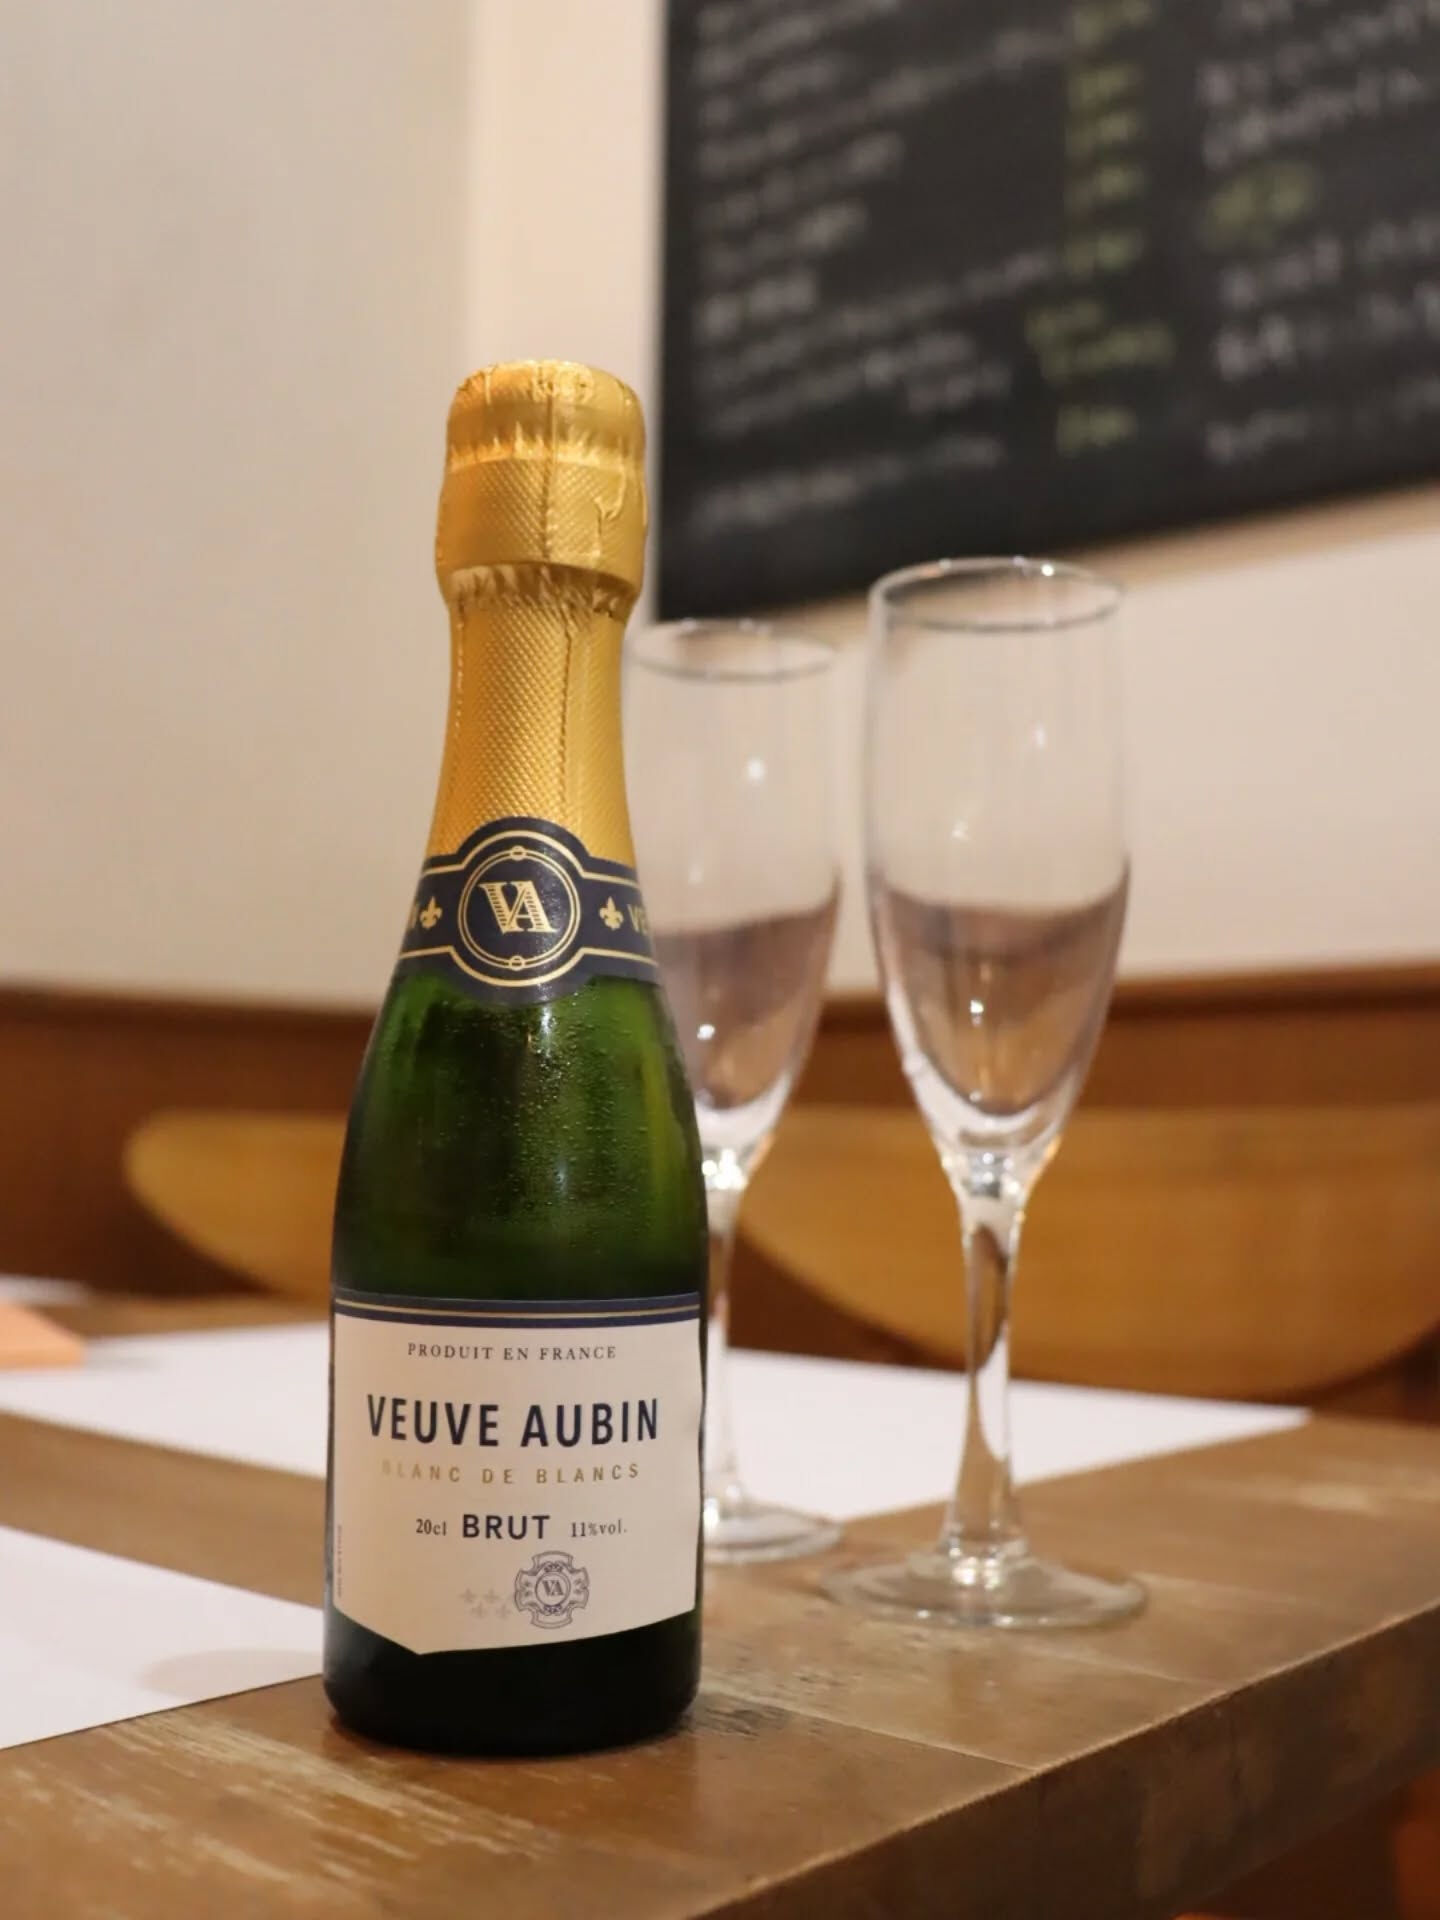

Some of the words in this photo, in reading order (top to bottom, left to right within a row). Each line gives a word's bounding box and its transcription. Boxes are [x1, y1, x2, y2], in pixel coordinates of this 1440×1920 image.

[478, 880, 558, 934] VA
[407, 1341, 494, 1361] PRODUIT
[503, 1346, 530, 1361] EN
[539, 1345, 617, 1361] FRANCE
[366, 1394, 500, 1447] VEUVE
[520, 1398, 658, 1448] AUBIN
[381, 1458, 461, 1482] BLANC
[481, 1467, 514, 1485] DE
[536, 1462, 640, 1484] BLANCS
[415, 1517, 447, 1537] 20cl
[462, 1513, 551, 1541] BRUT
